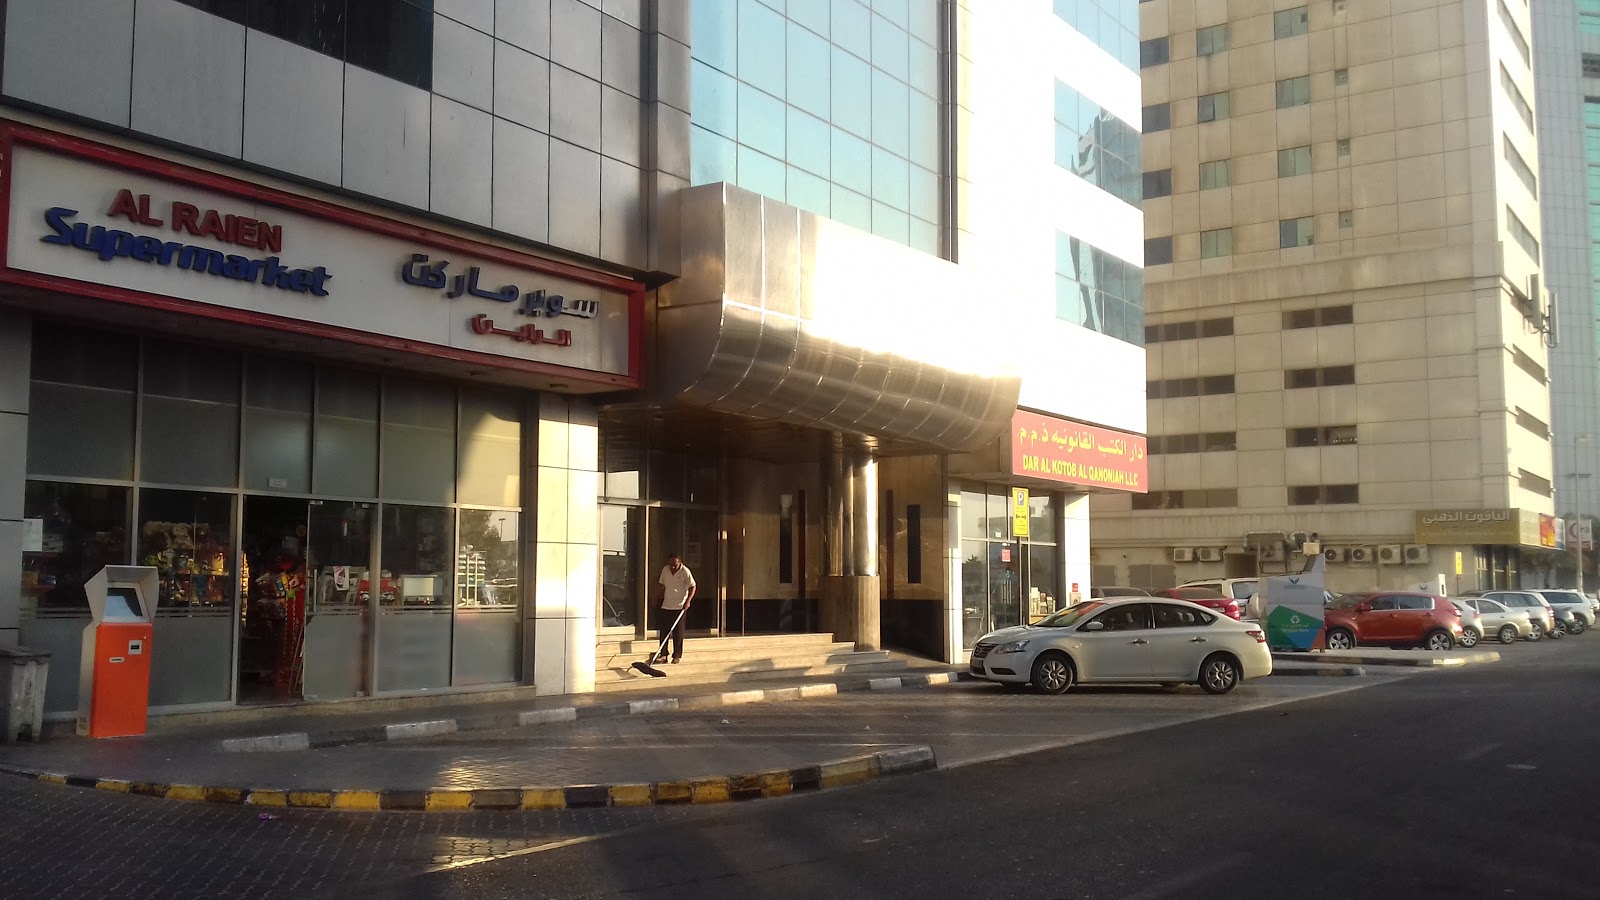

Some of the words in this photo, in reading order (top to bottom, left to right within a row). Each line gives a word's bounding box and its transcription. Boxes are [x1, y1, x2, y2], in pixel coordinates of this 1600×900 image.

[107, 188, 163, 227] AL
[171, 201, 282, 252] RAIEN
[40, 206, 333, 296] Supermarket
[402, 253, 519, 303] ماركت
[1097, 438, 1127, 458] الكتب
[1129, 443, 1144, 462] دار
[1023, 454, 1039, 471] DAR
[1040, 458, 1051, 474] AL
[1052, 459, 1077, 477] KOTOB
[1078, 464, 1088, 479] AL
[1089, 466, 1124, 484] QANONIAH
[1125, 472, 1139, 487] LLC
[1423, 511, 1463, 528] الذهبي
[1465, 510, 1510, 523] الياقوت
